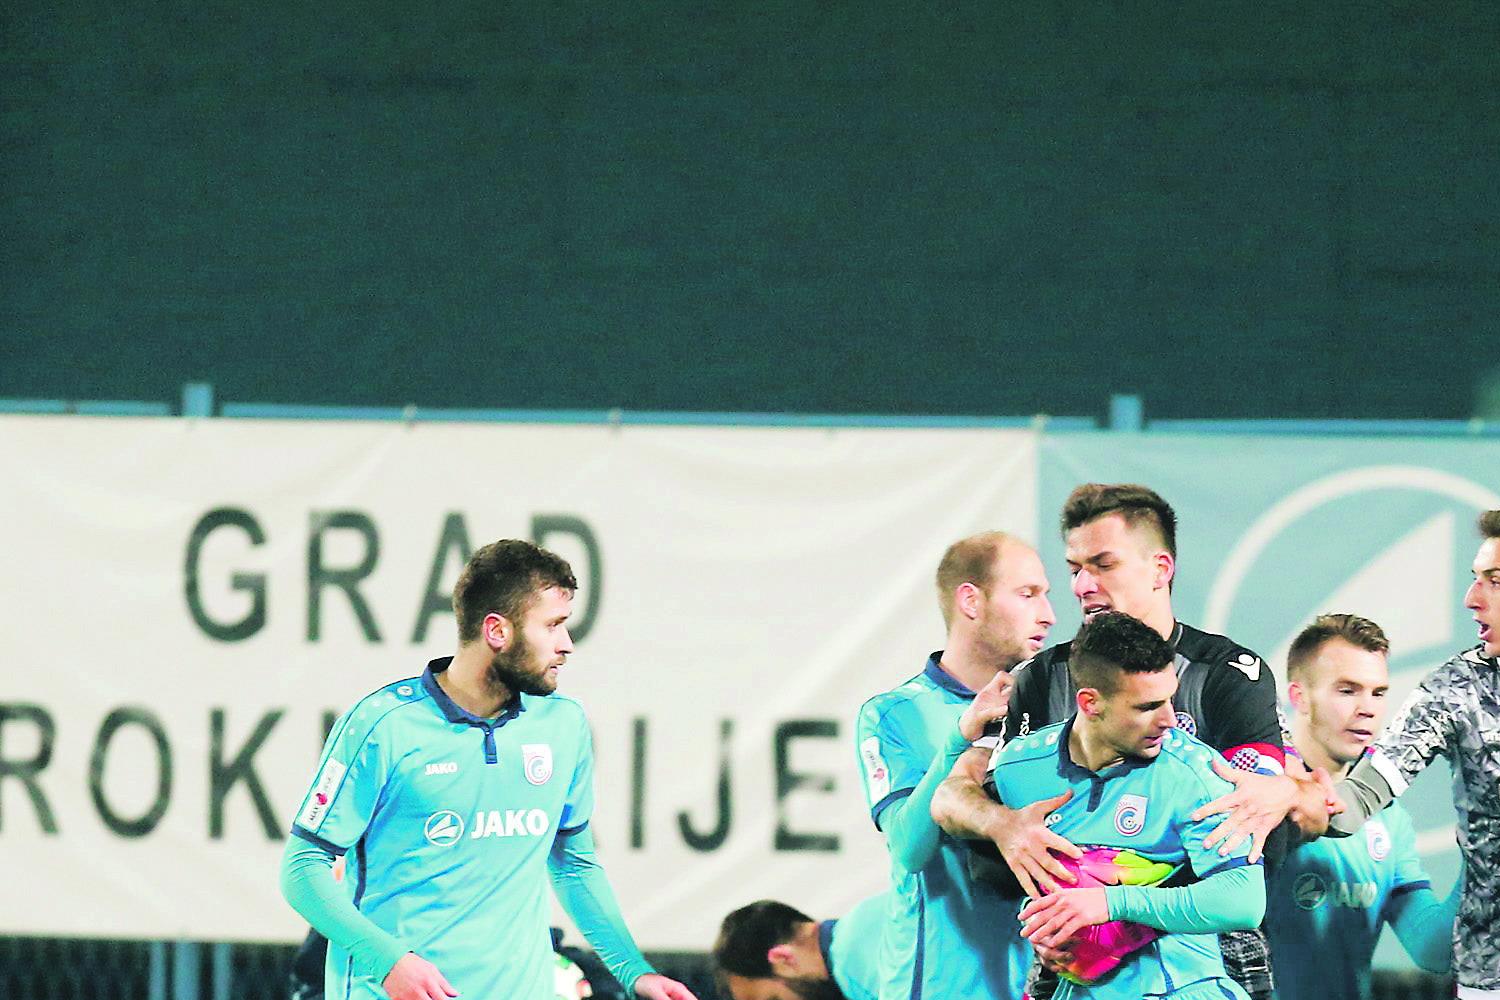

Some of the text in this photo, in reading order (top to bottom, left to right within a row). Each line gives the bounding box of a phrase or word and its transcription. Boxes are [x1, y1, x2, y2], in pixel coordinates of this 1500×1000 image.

[184, 507, 604, 644] GRAD
[425, 762, 458, 776] JAKO
[471, 808, 549, 840] JAKO
